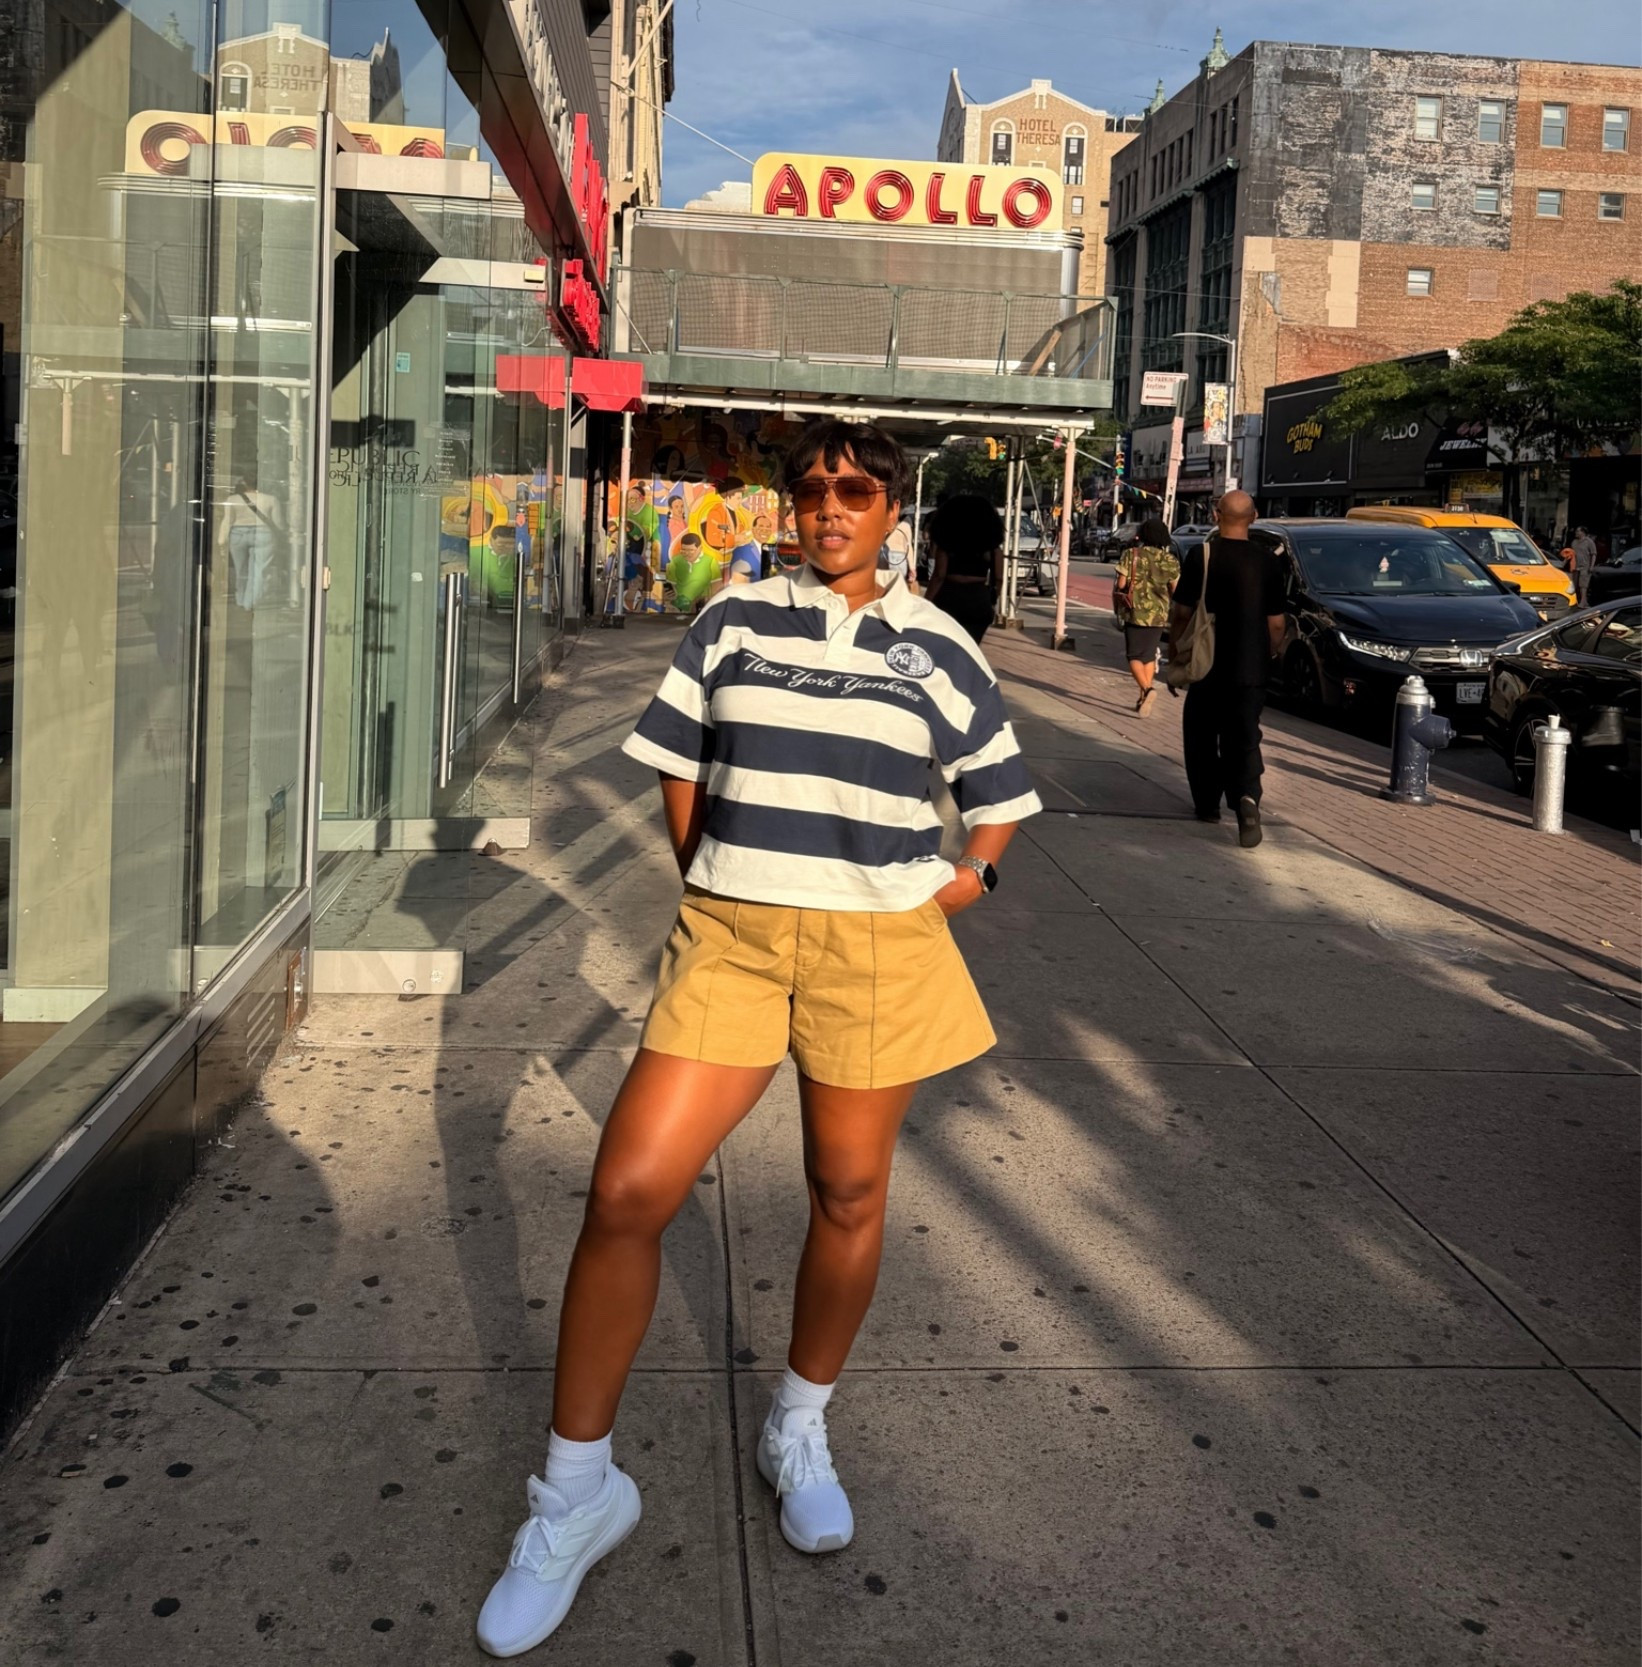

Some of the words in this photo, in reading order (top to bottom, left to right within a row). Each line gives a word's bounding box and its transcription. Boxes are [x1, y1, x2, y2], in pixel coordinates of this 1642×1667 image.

[1019, 118, 1057, 132] HOTEL
[1016, 131, 1061, 146] THERESA
[763, 163, 1053, 229] APOLLO
[1286, 421, 1323, 444] GOTHAM
[1381, 422, 1420, 441] ALDO
[1293, 438, 1314, 455] BUDS
[744, 652, 788, 677] New
[787, 667, 840, 688] York
[840, 675, 924, 703] Yankees
